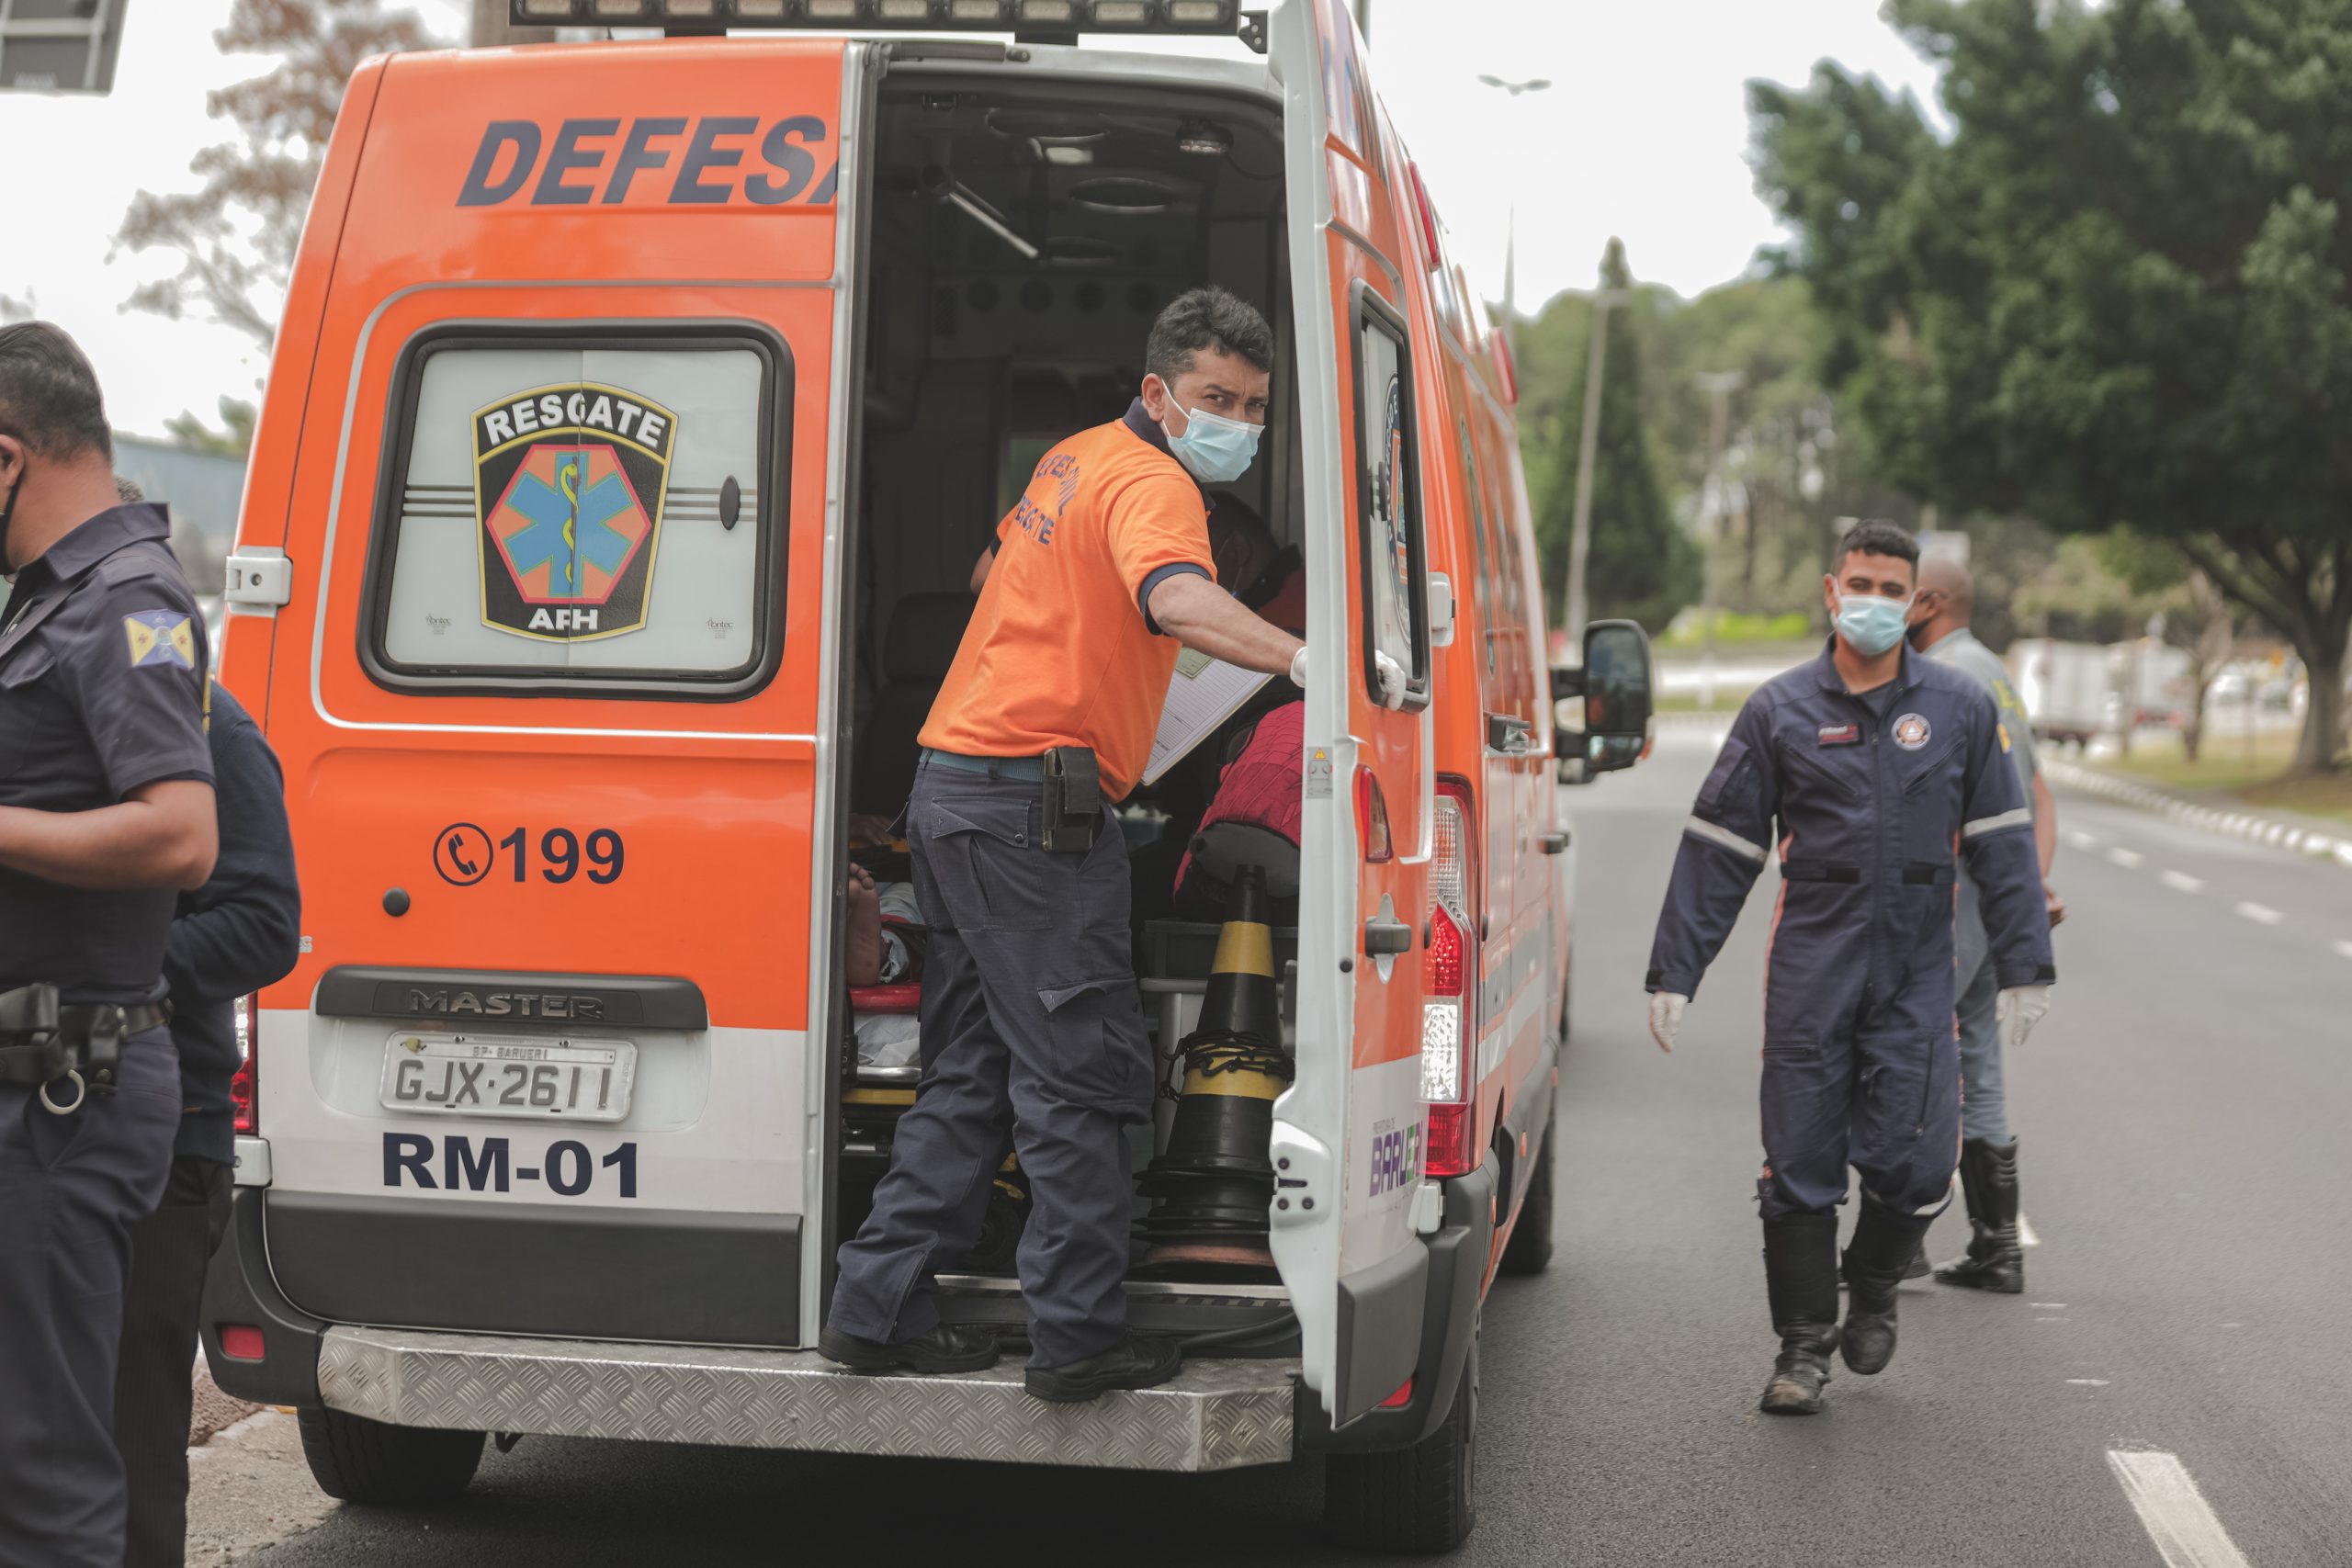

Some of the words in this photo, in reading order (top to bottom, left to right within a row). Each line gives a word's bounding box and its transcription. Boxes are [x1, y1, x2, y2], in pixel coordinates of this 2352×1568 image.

[484, 392, 667, 449] RESGATE
[500, 828, 625, 885] 199
[411, 989, 604, 1019] MASTER
[497, 1047, 548, 1059] BARUERI
[383, 1133, 637, 1198] RM-01
